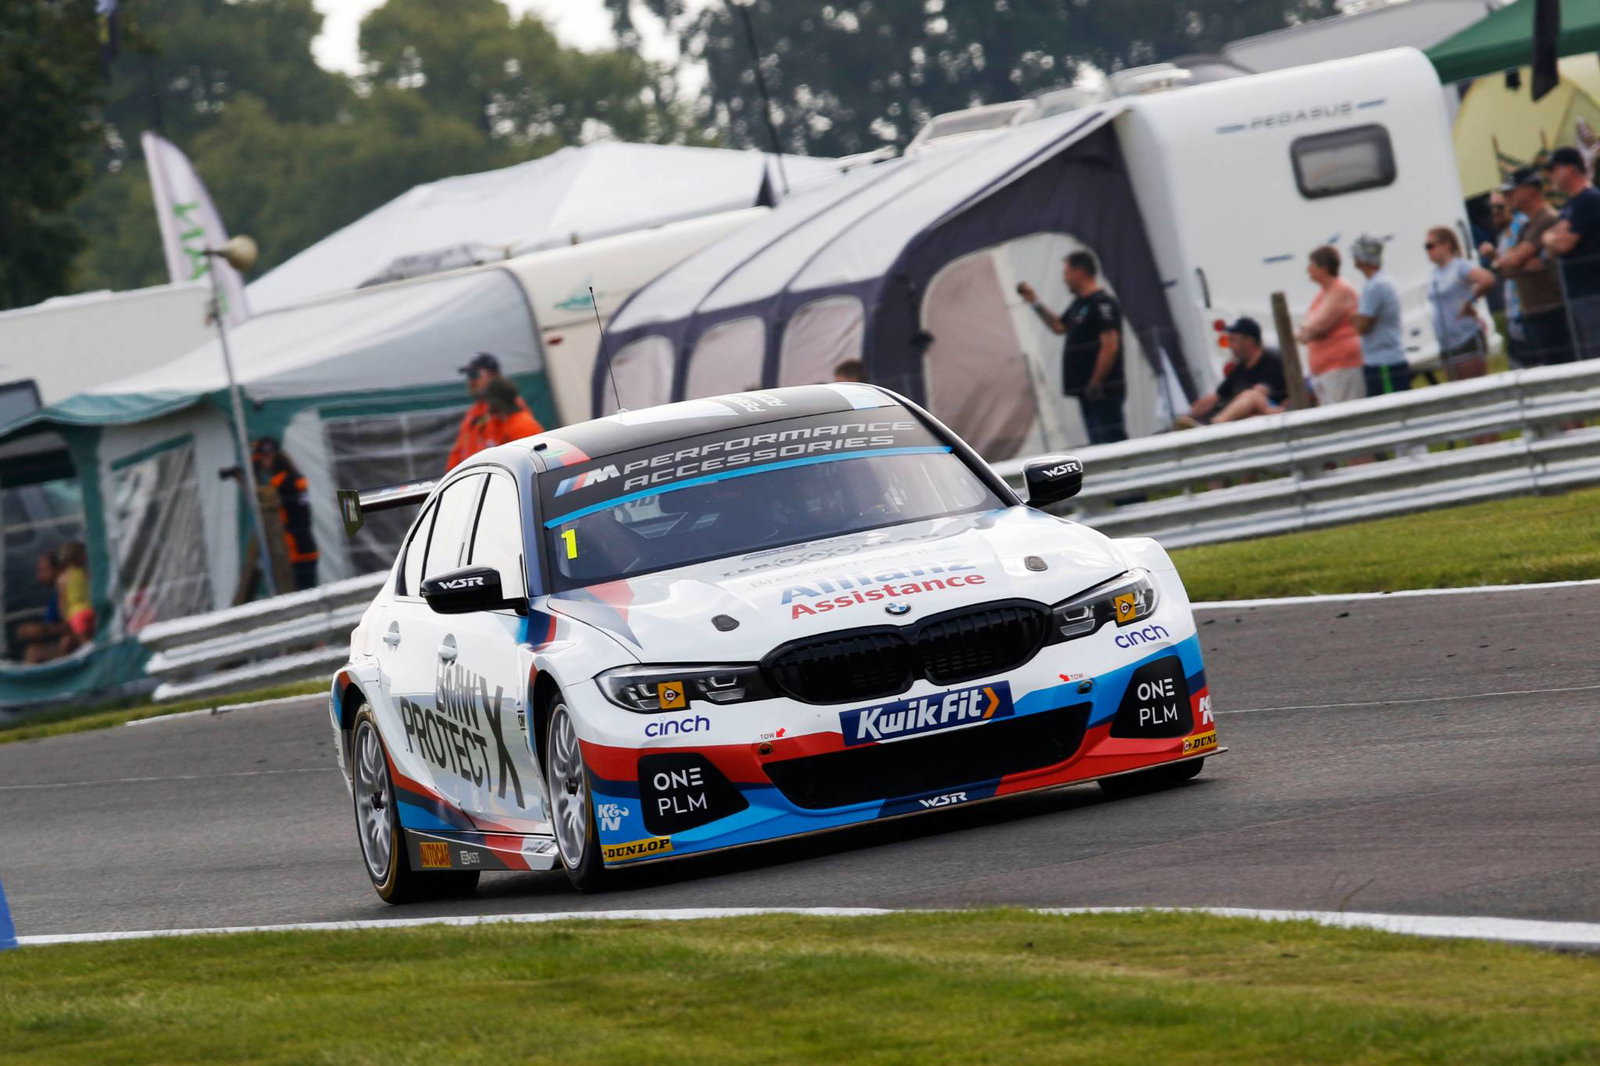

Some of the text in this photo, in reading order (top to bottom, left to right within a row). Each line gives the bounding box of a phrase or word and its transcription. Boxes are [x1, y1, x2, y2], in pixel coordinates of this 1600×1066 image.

[1251, 103, 1352, 128] PEGASUS
[623, 421, 916, 475] PERFORMANCE
[623, 435, 894, 491] ACCESSORIES
[1042, 462, 1079, 477] WSR
[561, 528, 578, 560] 1
[438, 576, 485, 590] WSR
[780, 559, 977, 605] Allianz
[791, 574, 986, 620] Assistance
[1115, 625, 1169, 649] cinch
[1070, 673, 1084, 681] TOW
[1137, 678, 1176, 701] ONE
[644, 714, 711, 738] cinch
[1139, 703, 1178, 727] PLM
[400, 695, 492, 793] PROTECT
[760, 732, 776, 741] TOW
[653, 766, 704, 791] ONE
[657, 792, 708, 816] PLM
[919, 792, 969, 808] WSR
[607, 838, 671, 858] DUNLOP
